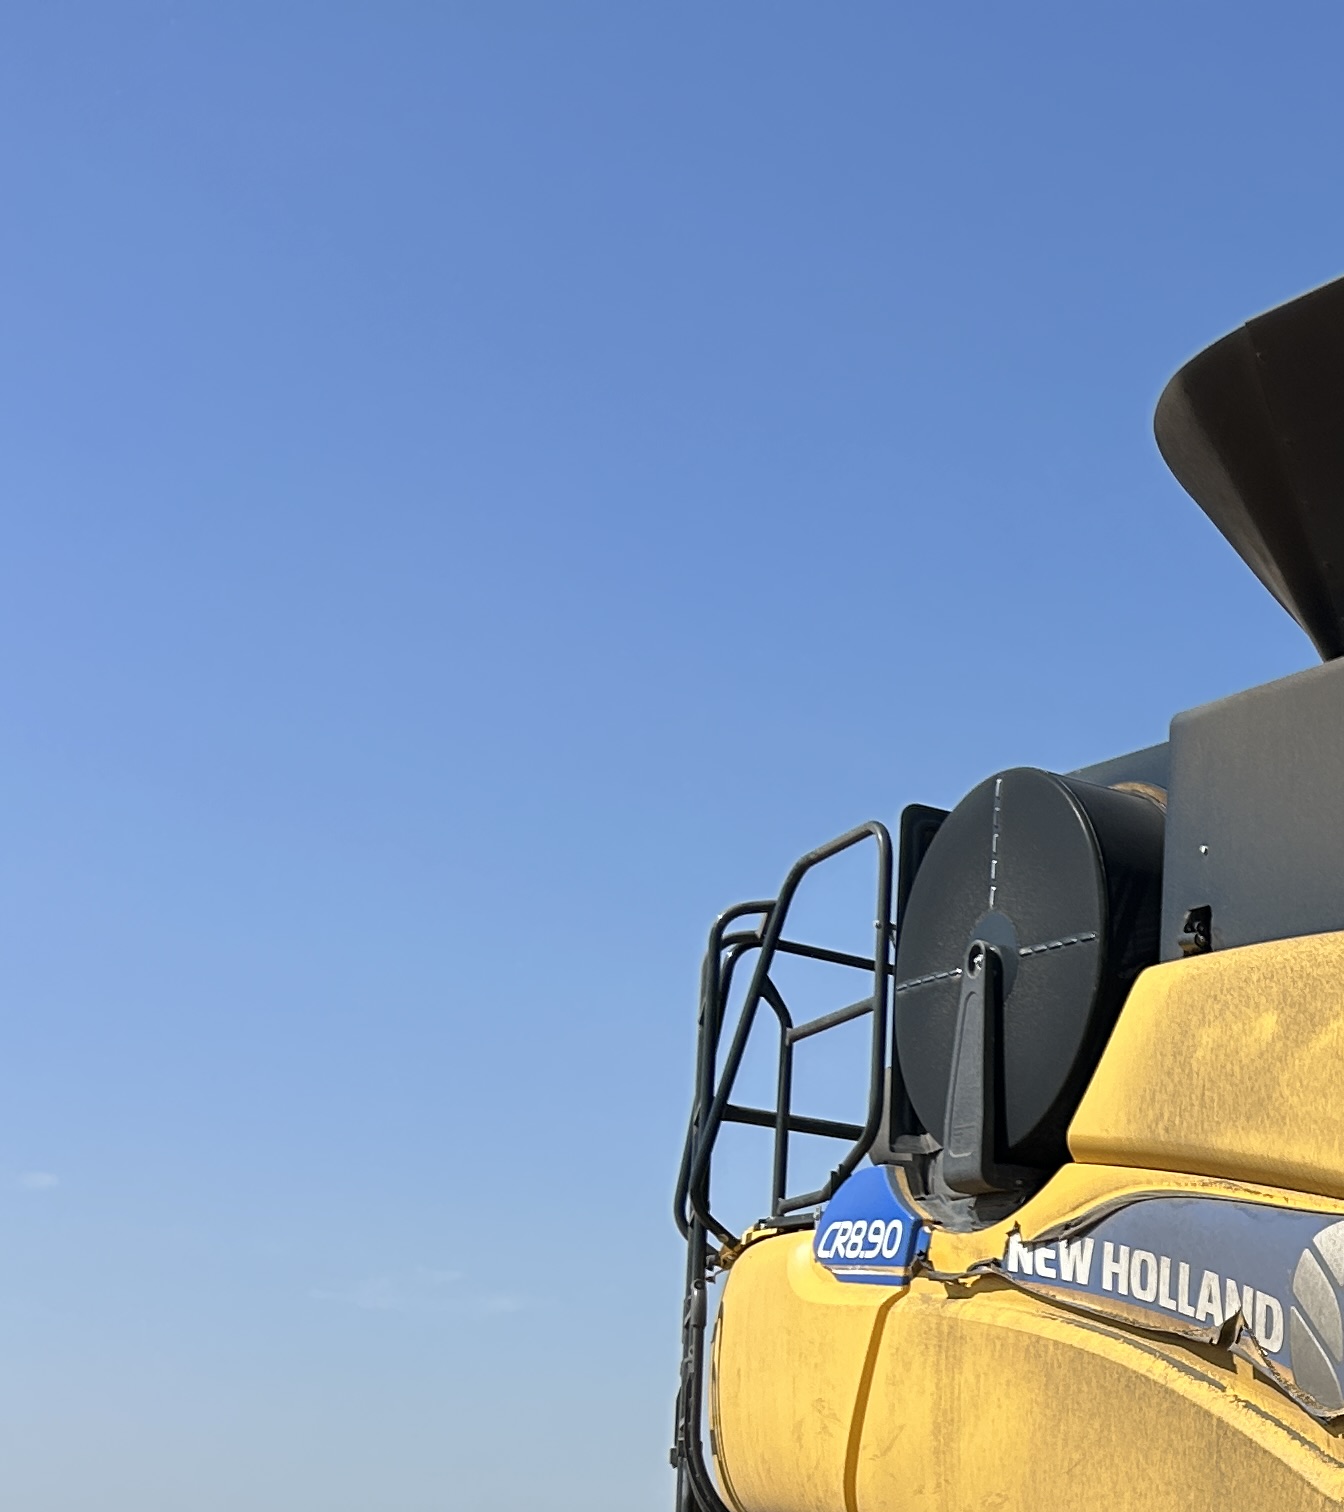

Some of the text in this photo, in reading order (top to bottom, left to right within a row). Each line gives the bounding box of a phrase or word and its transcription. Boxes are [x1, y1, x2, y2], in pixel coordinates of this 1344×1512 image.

[817, 1219, 903, 1259] CR8.90
[1007, 1232, 1284, 1354] NEW HOLLAND
